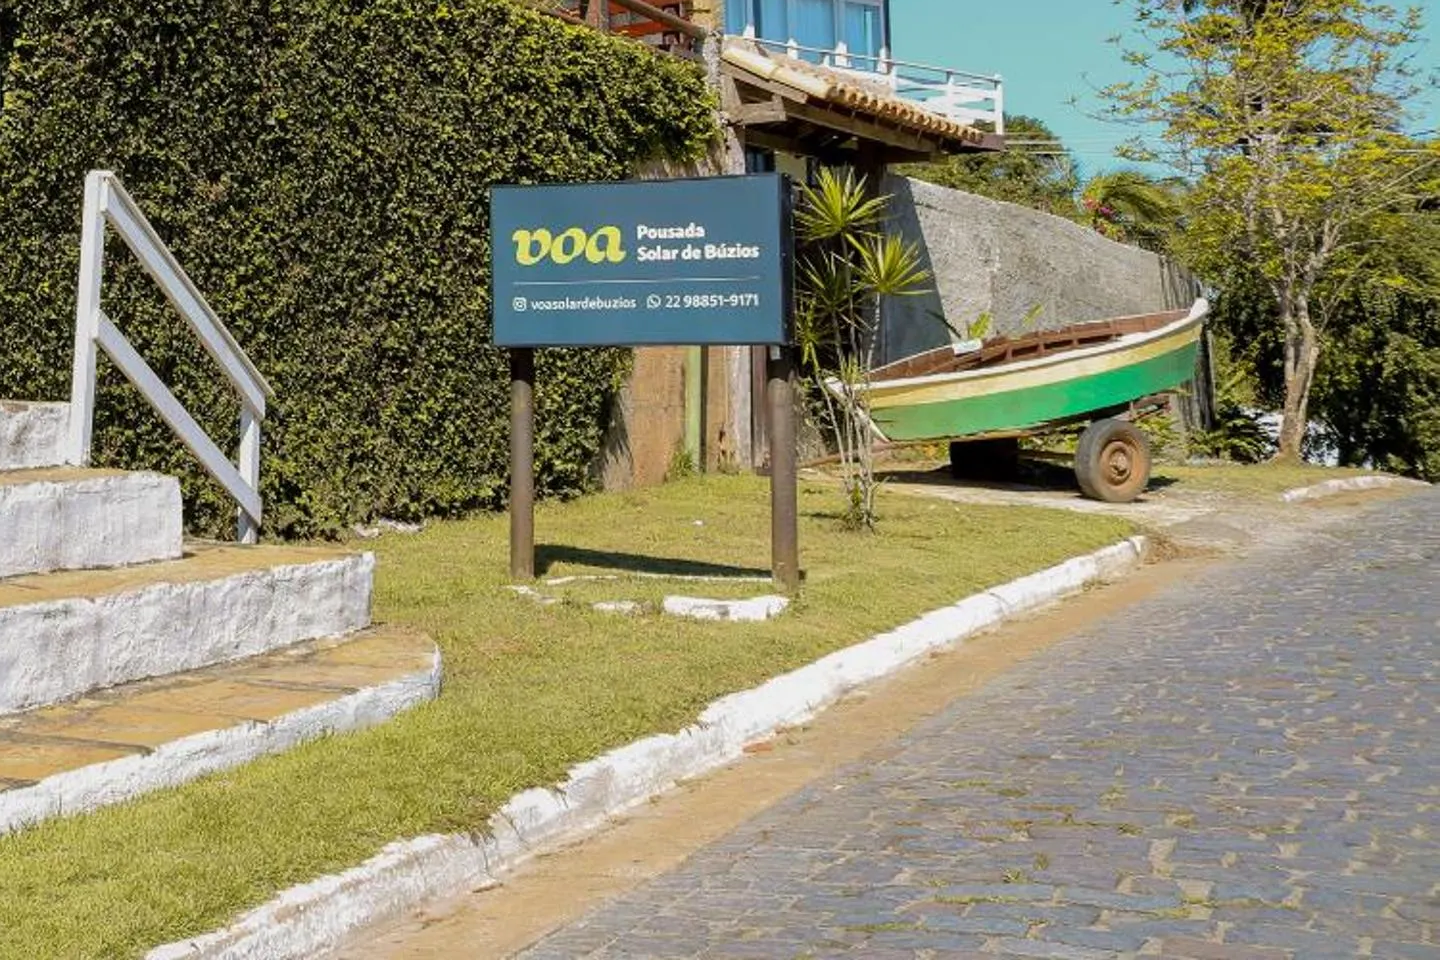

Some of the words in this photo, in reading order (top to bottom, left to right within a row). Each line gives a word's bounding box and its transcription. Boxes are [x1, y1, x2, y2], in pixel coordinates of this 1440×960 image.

[636, 222, 706, 240] Pousada
[512, 225, 627, 266] voa
[636, 245, 679, 262] Solar
[681, 244, 702, 260] de
[704, 242, 760, 259] Búzios
[530, 296, 637, 311] voasolardebuzios
[665, 295, 681, 308] 22
[684, 293, 760, 308] 98851-9171
